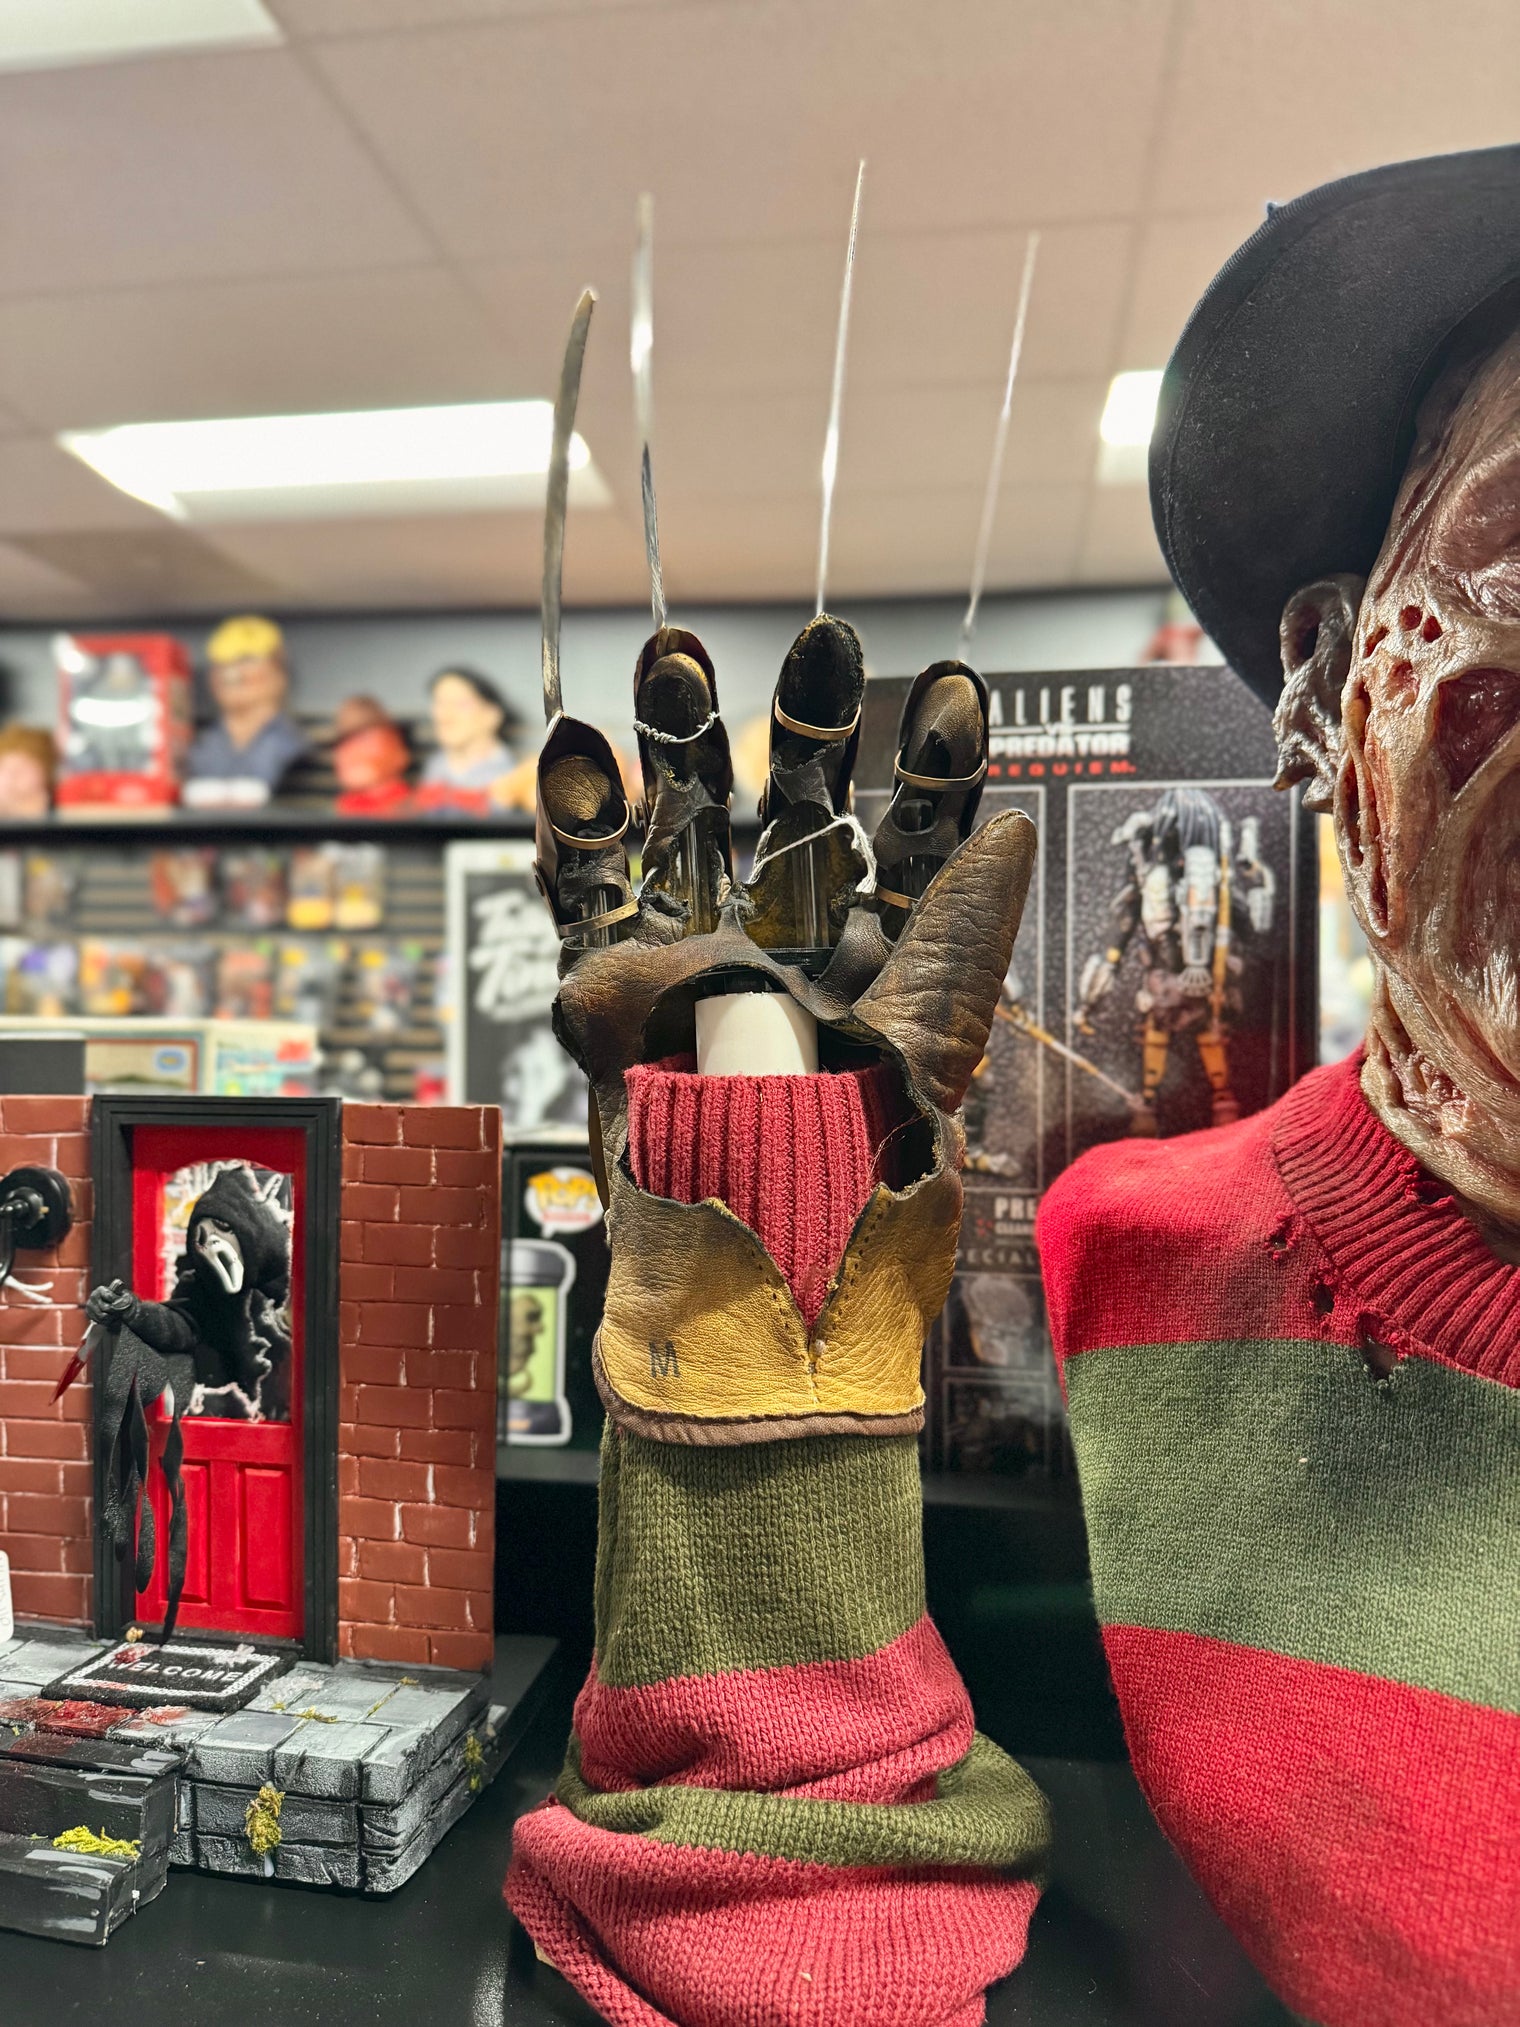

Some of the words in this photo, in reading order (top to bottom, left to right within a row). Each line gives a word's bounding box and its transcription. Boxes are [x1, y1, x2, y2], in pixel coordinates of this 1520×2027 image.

[989, 684, 1132, 726] ALIENS
[988, 732, 1130, 758] PREDATOR
[648, 1340, 680, 1378] M
[108, 1657, 244, 1682] WELCOME
